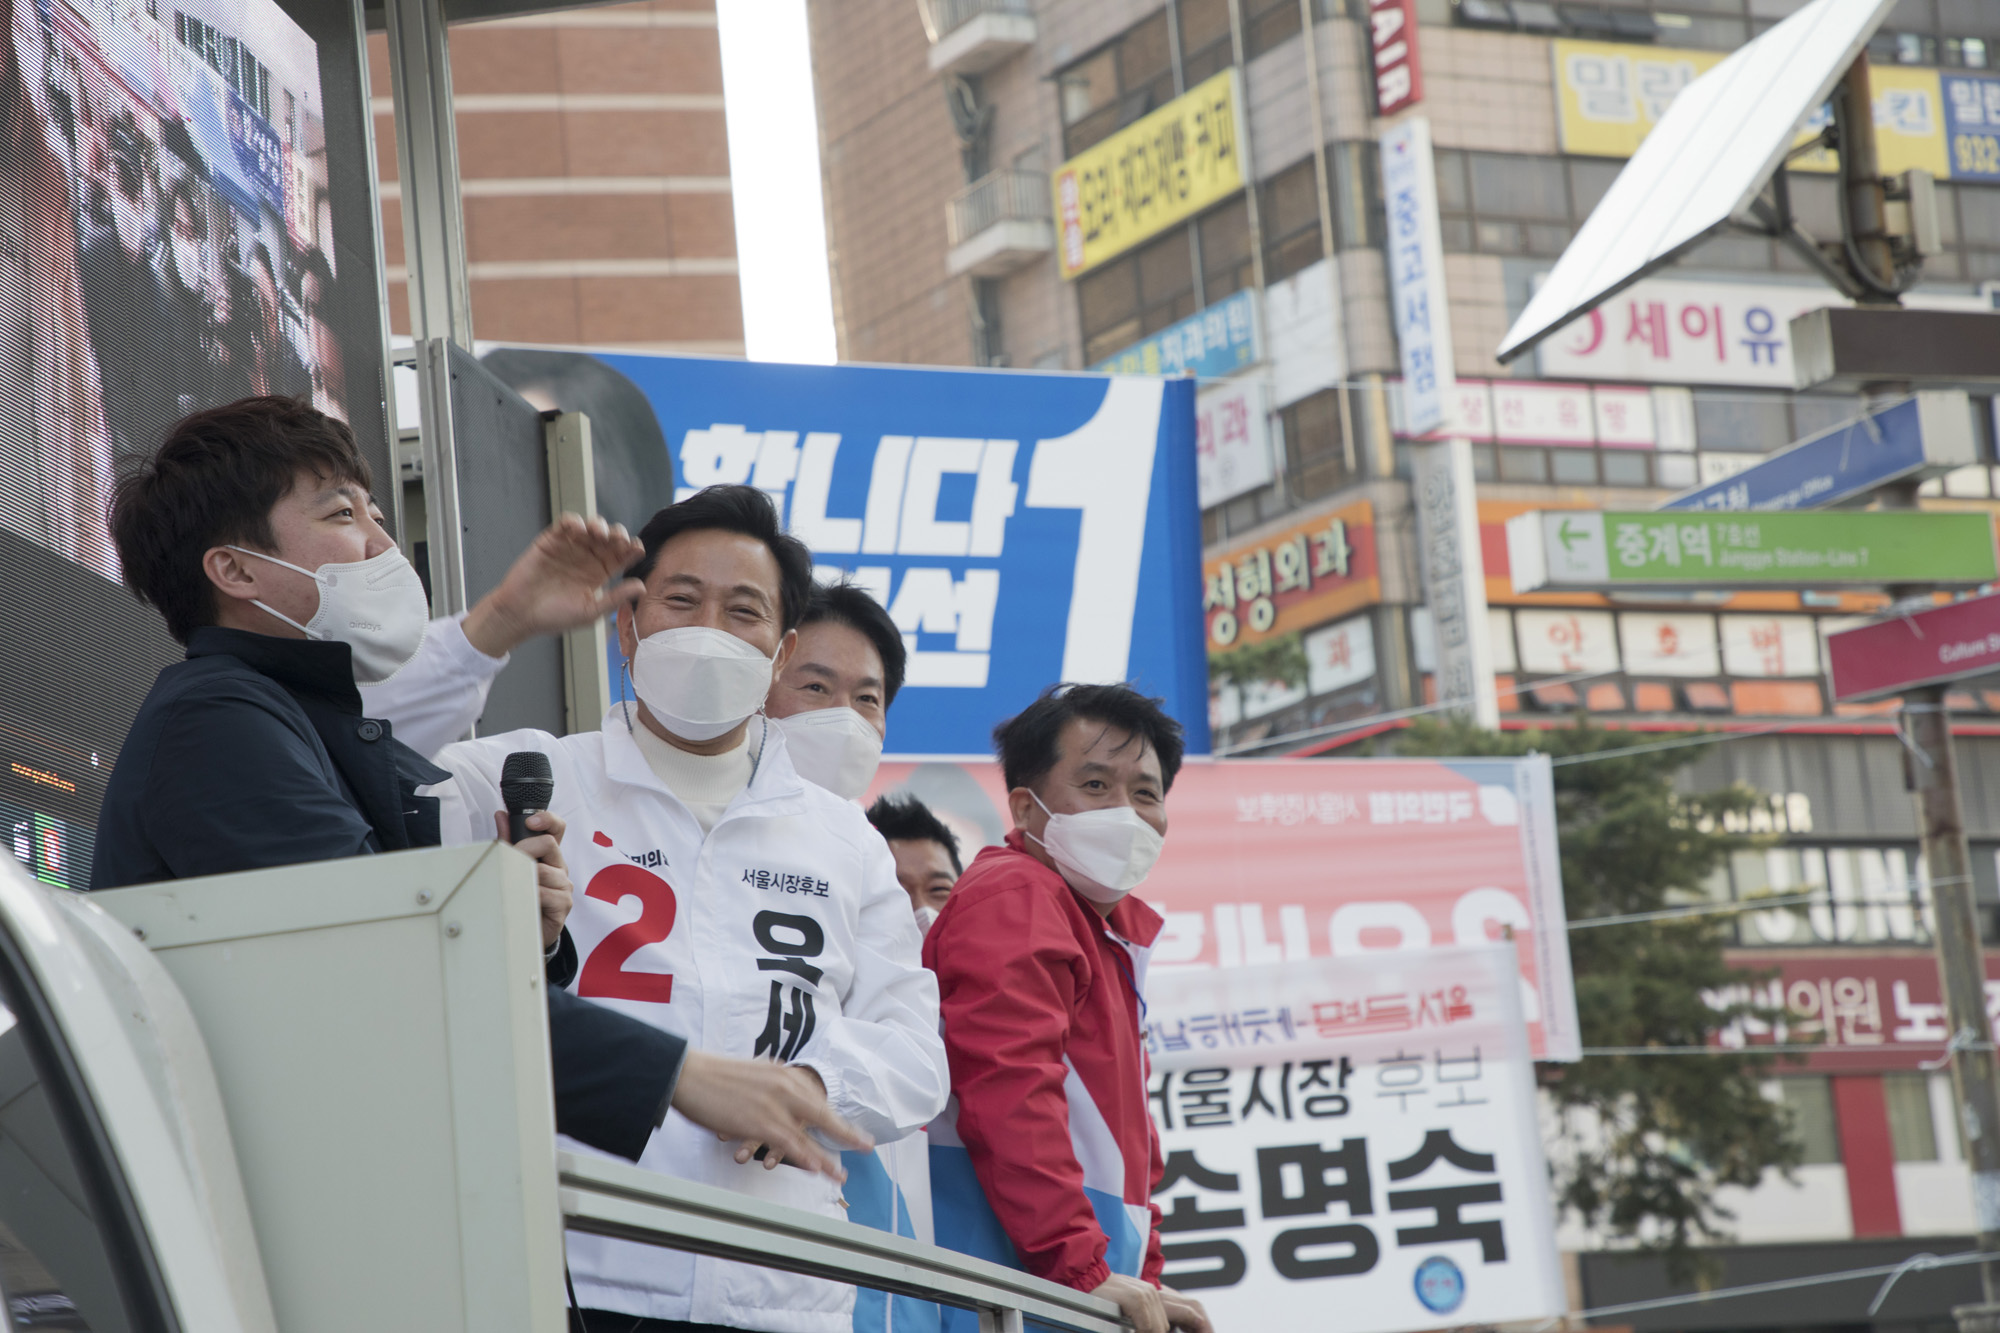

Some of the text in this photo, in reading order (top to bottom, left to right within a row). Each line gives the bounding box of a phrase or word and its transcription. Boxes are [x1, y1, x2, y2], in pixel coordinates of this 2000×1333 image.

[1370, 0, 1412, 110] AIR
[1625, 298, 1800, 366] 세이유
[1025, 378, 1165, 684] 1
[1615, 522, 1713, 568] 중계역
[349, 620, 382, 632] airdays
[742, 868, 829, 898] 서울시장후보
[577, 864, 677, 1004] 2
[753, 910, 824, 1067] 오세
[1376, 1045, 1489, 1114] 후보
[1150, 1129, 1507, 1290] 송명숙
